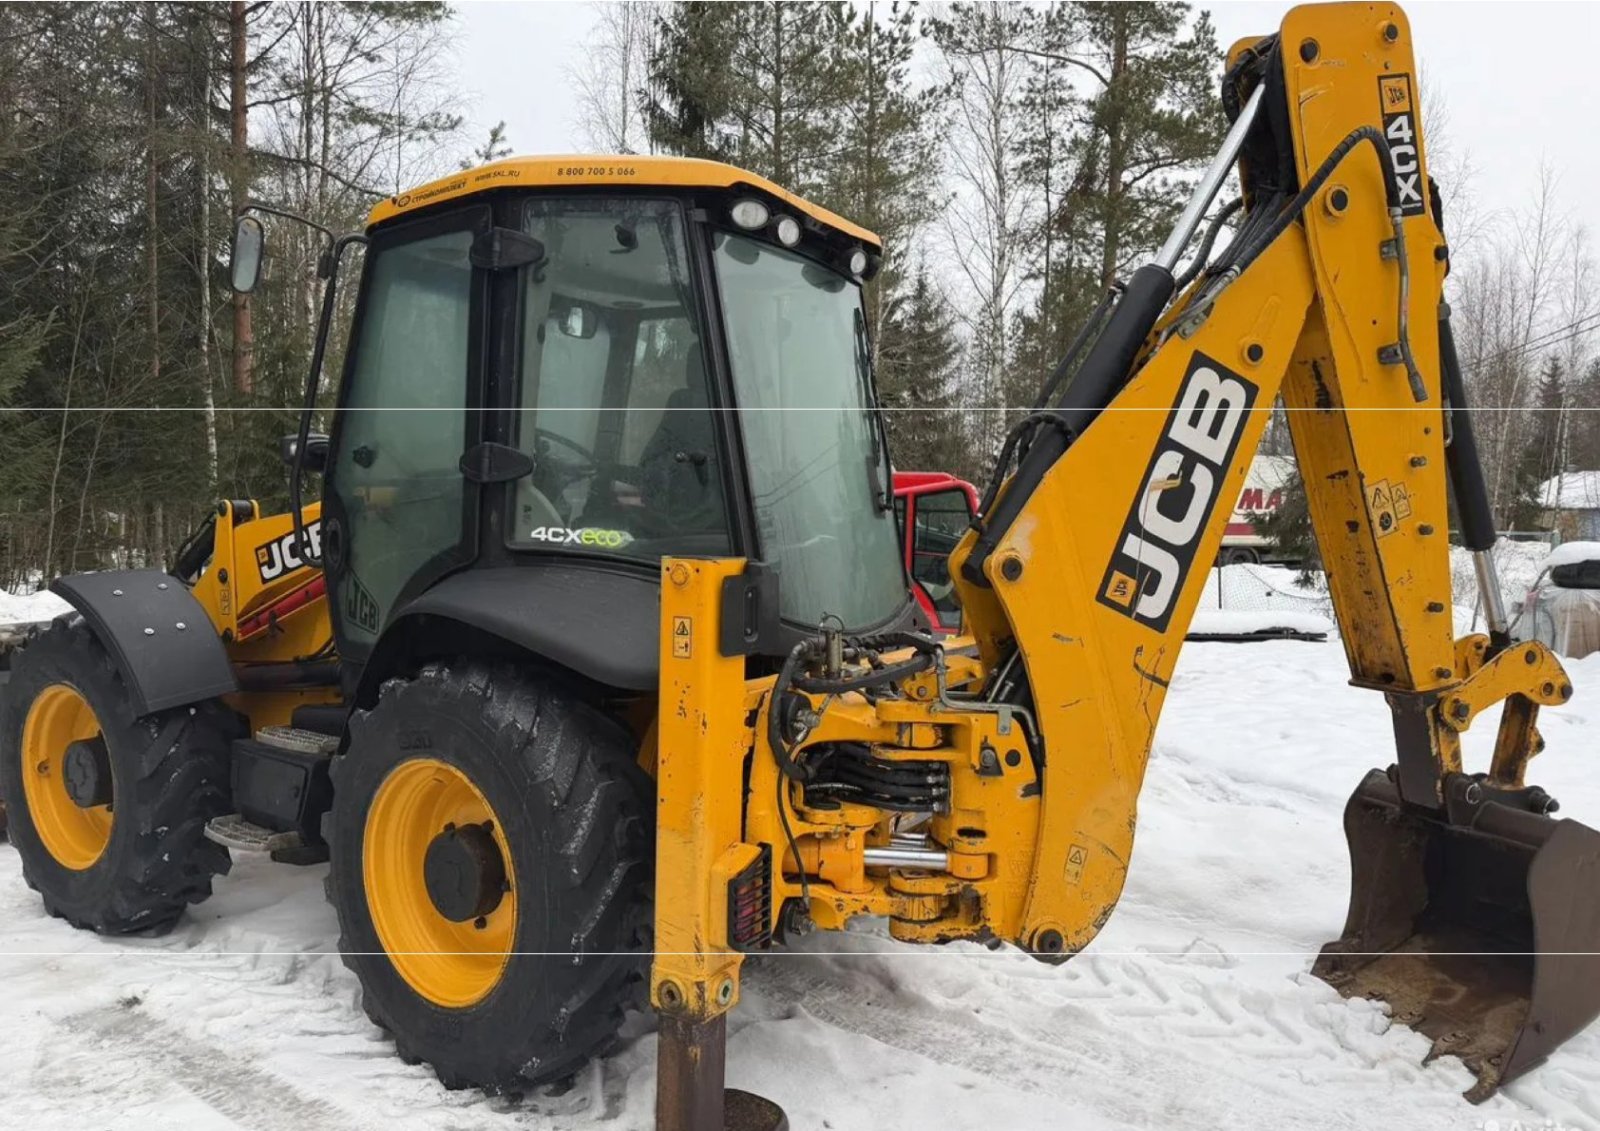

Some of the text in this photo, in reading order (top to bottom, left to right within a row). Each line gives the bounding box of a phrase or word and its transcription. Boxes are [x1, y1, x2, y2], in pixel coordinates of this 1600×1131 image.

[557, 167, 564, 177] 8
[565, 167, 584, 177] 800
[588, 167, 605, 176] 700
[617, 167, 635, 176] 066
[1387, 115, 1422, 203] 4CX
[1122, 366, 1247, 619] JCB
